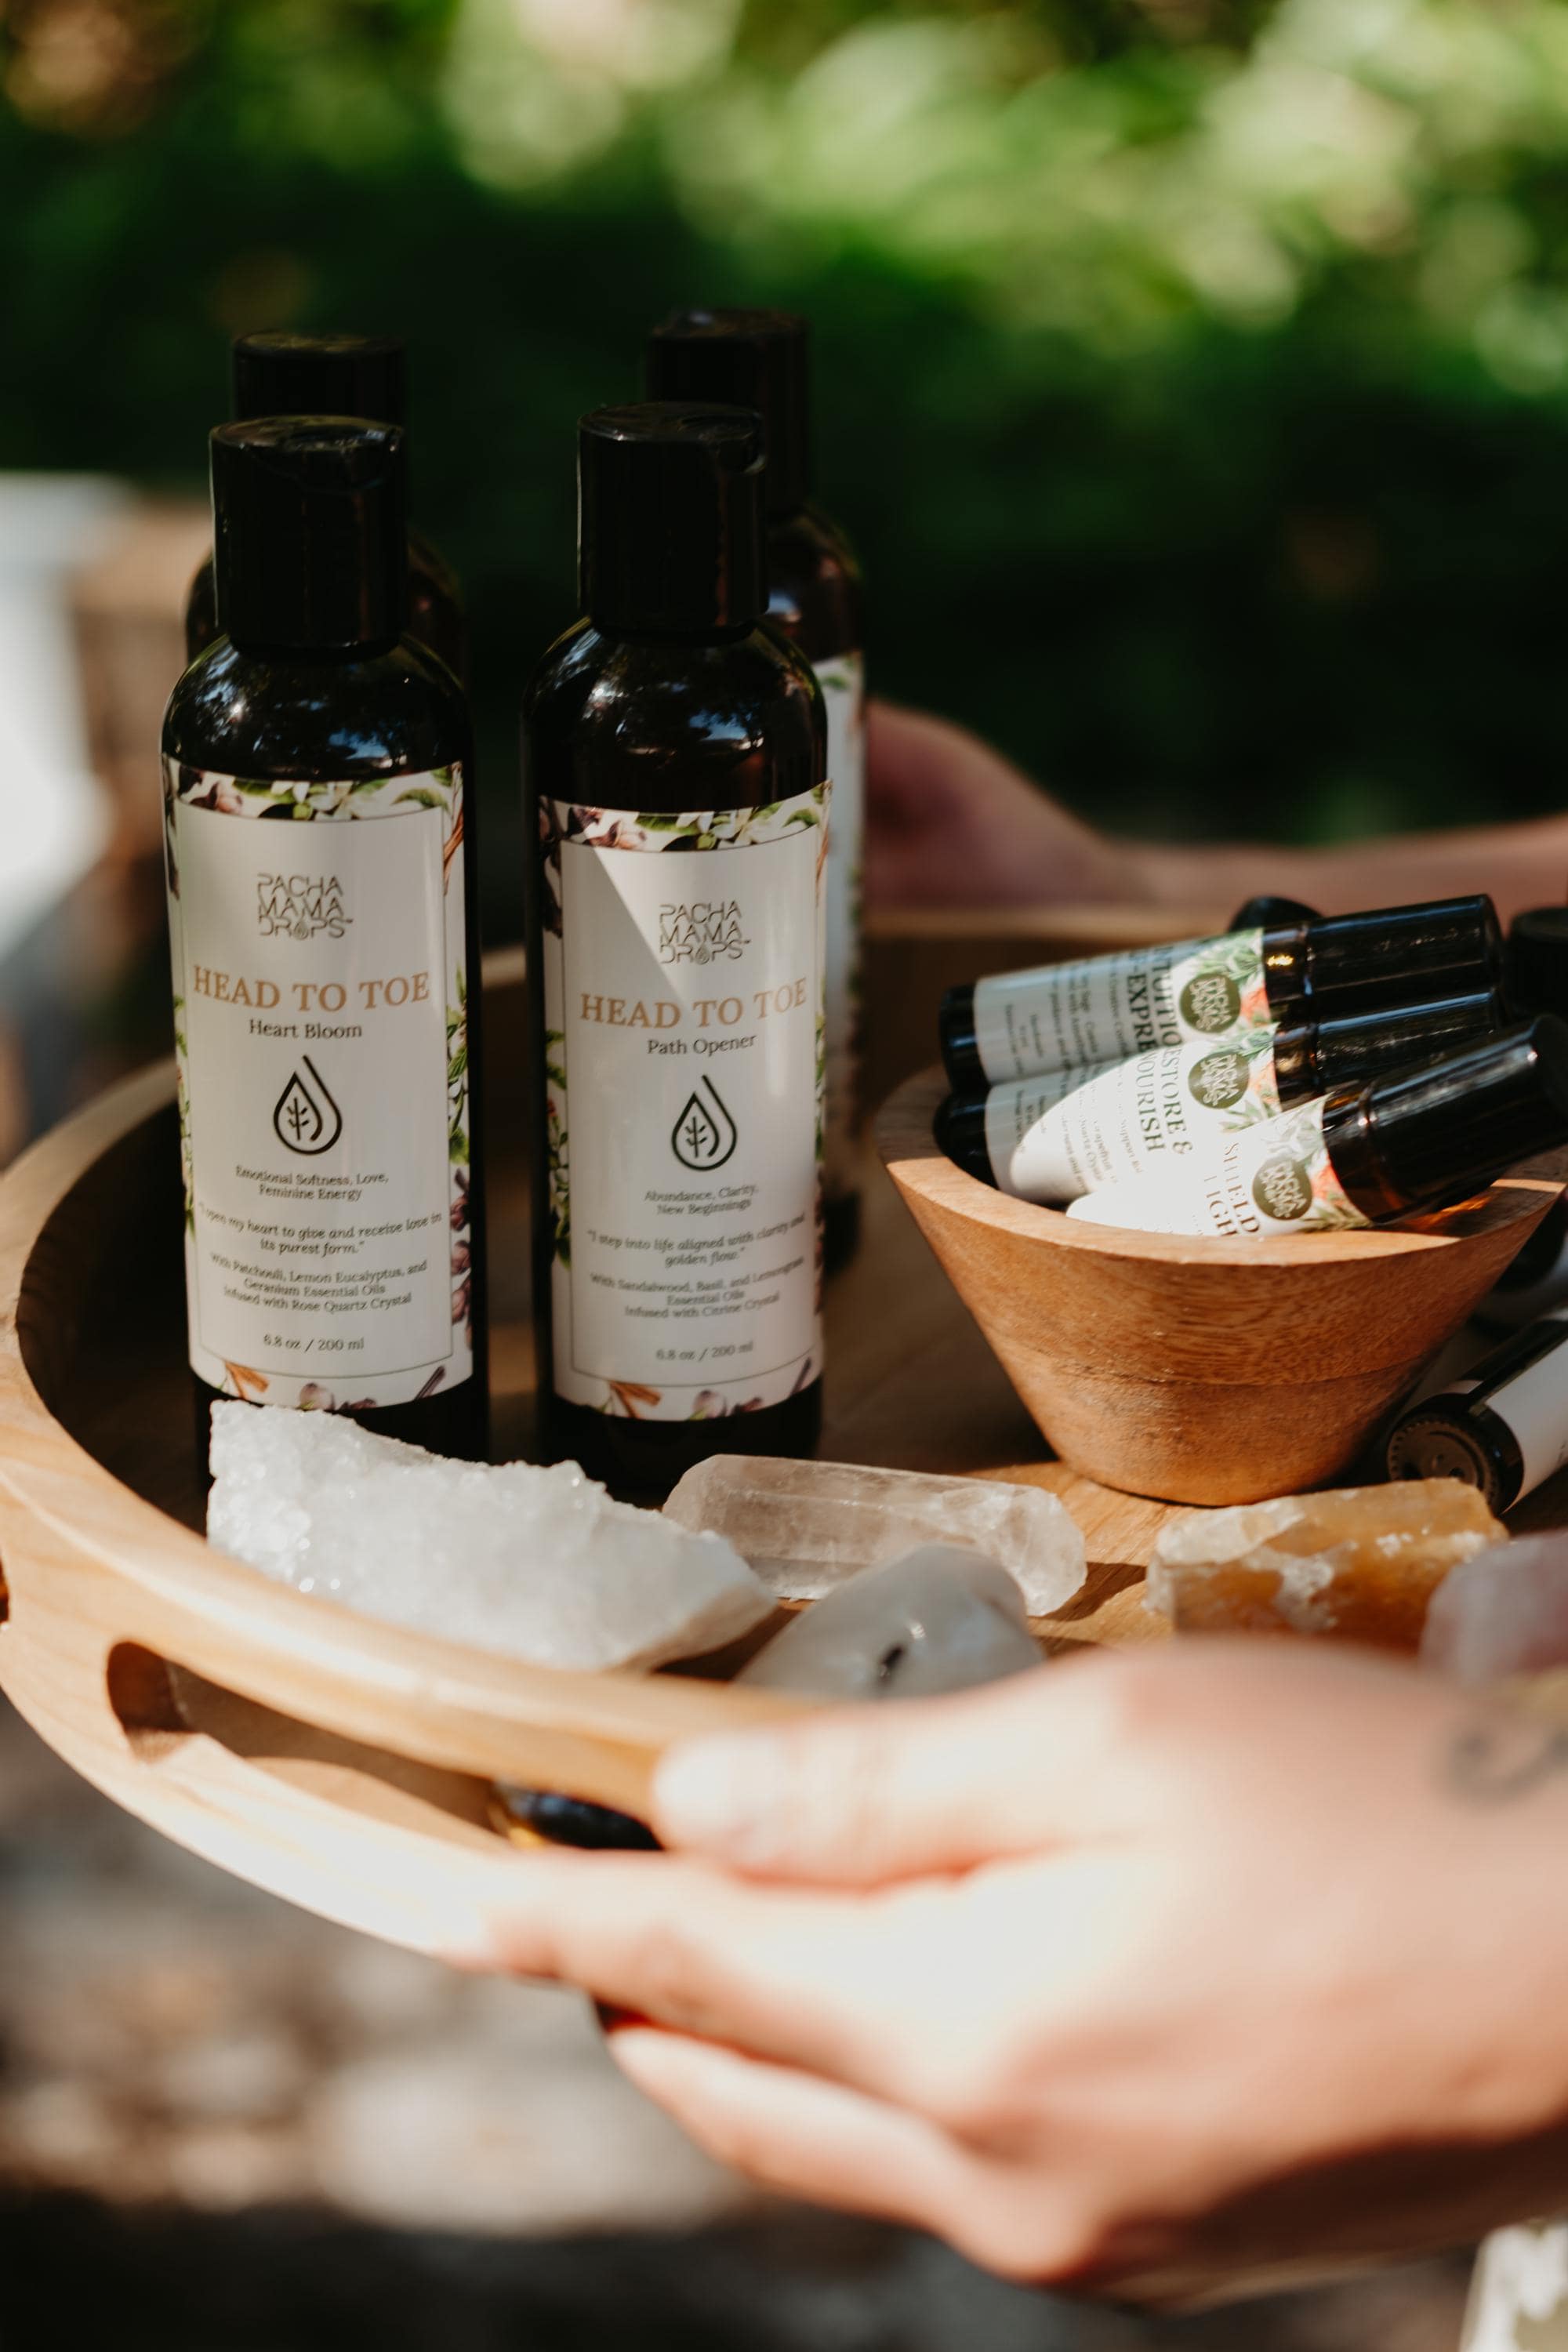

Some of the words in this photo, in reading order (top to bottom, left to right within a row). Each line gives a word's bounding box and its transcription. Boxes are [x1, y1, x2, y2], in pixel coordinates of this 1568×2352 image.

[257, 873, 343, 896] PACHA
[258, 896, 344, 917] MAMA
[659, 900, 742, 924] PACHA
[659, 920, 742, 943] MAMA
[194, 966, 280, 1010] HEAD
[292, 983, 347, 1011] TO
[359, 972, 430, 1009] TOE
[581, 993, 681, 1029] HEAD
[692, 998, 742, 1027] TO
[753, 978, 807, 1019] TOE
[249, 1020, 299, 1038] Heart
[306, 1022, 362, 1039] Bloom
[648, 1040, 687, 1054] Path
[693, 1035, 757, 1057] Opener
[1136, 1052, 1166, 1151] NOURISH
[1173, 1141, 1192, 1154] &
[236, 1165, 292, 1185] Emotional
[356, 1173, 389, 1185] Love,
[259, 1184, 314, 1200] Feminine
[318, 1187, 362, 1201] Energy
[657, 1203, 686, 1215] New
[689, 1199, 751, 1217] Beginnings
[247, 1218, 279, 1236] heart
[282, 1225, 295, 1237] to
[299, 1226, 325, 1241] give
[328, 1226, 354, 1239] and
[358, 1222, 402, 1237] receive
[278, 1242, 320, 1256] purest
[625, 1237, 651, 1250] into
[654, 1237, 674, 1253] life
[678, 1236, 724, 1252] aligned
[728, 1232, 754, 1246] with
[290, 1270, 332, 1283] Lemon
[407, 1259, 427, 1274] and
[665, 1253, 706, 1269] golden
[244, 1278, 300, 1296] Geranium
[304, 1283, 358, 1297] Essential
[362, 1284, 386, 1295] Oils
[730, 1274, 750, 1287] and
[263, 1297, 289, 1309] with
[292, 1299, 321, 1311] Rose
[324, 1300, 368, 1314] Quartz
[370, 1291, 412, 1310] Crystal
[666, 1294, 720, 1306] Essential
[673, 1307, 699, 1317] with
[318, 1338, 343, 1351] 200
[347, 1337, 365, 1349] ml
[712, 1345, 735, 1358] 200
